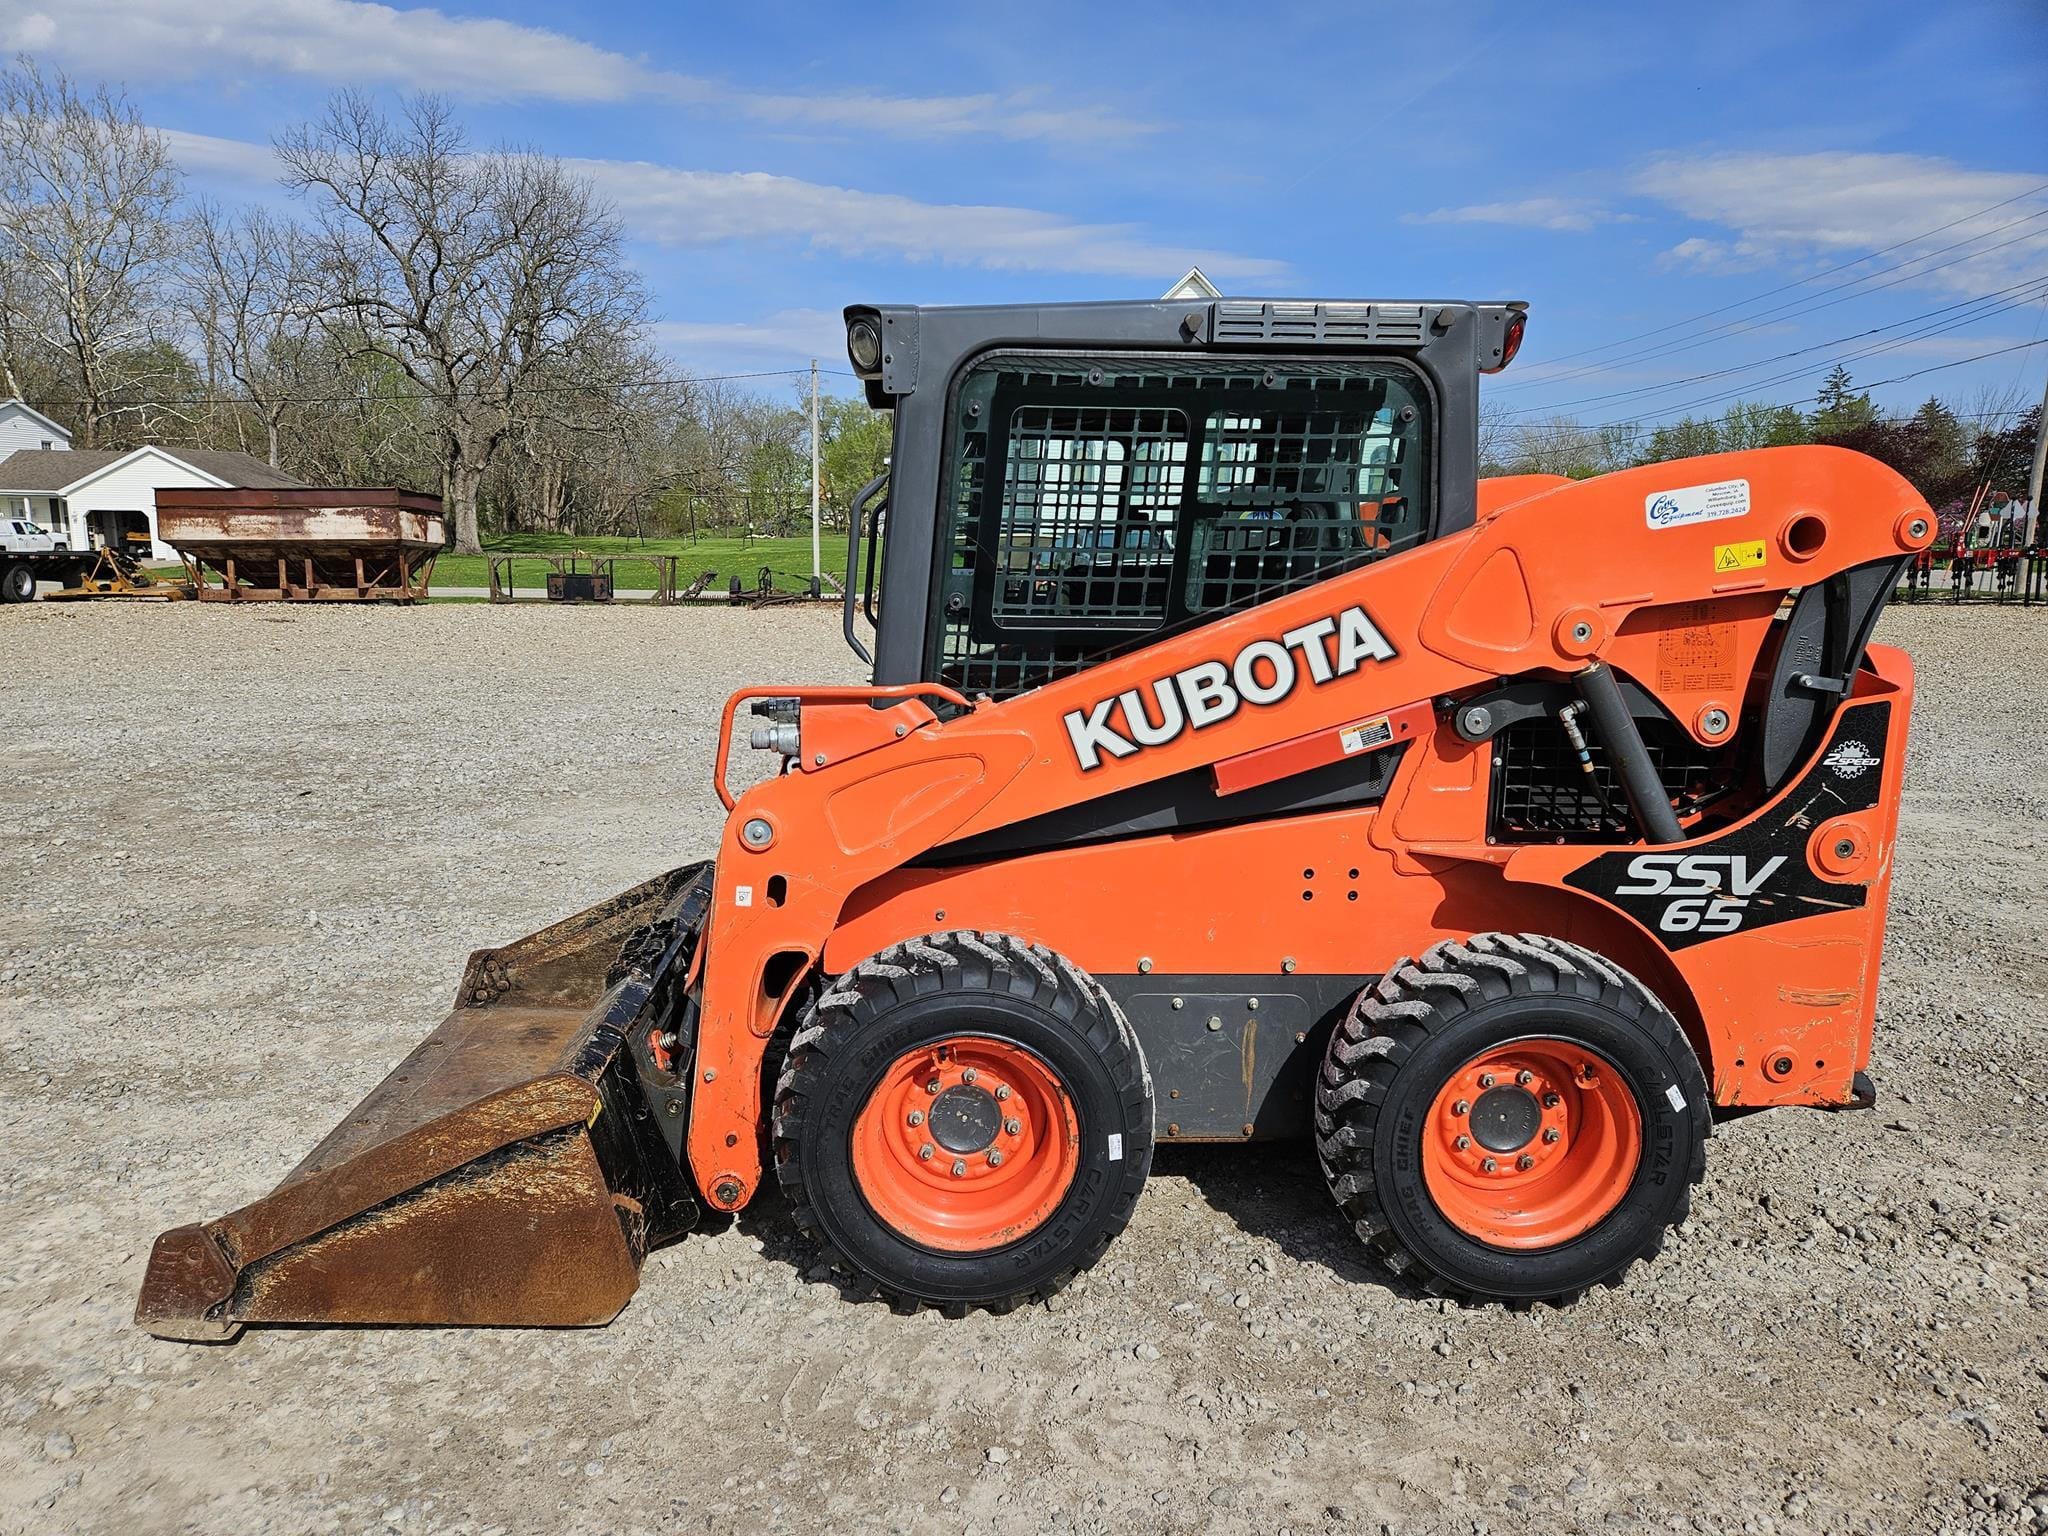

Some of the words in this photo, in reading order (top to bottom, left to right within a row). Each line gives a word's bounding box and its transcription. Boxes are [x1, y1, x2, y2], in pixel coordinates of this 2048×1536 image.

[1660, 509, 1703, 524] Equipment
[1707, 506, 1746, 518] 319.728.2424
[1064, 606, 1397, 771] KUBOTA
[1615, 854, 1788, 896] SSV
[1659, 899, 1750, 932] 65
[1397, 1107, 1416, 1172] CHIEF
[1638, 1066, 1673, 1186] CARLSTAR
[1012, 1168, 1101, 1268] CARLSTAR
